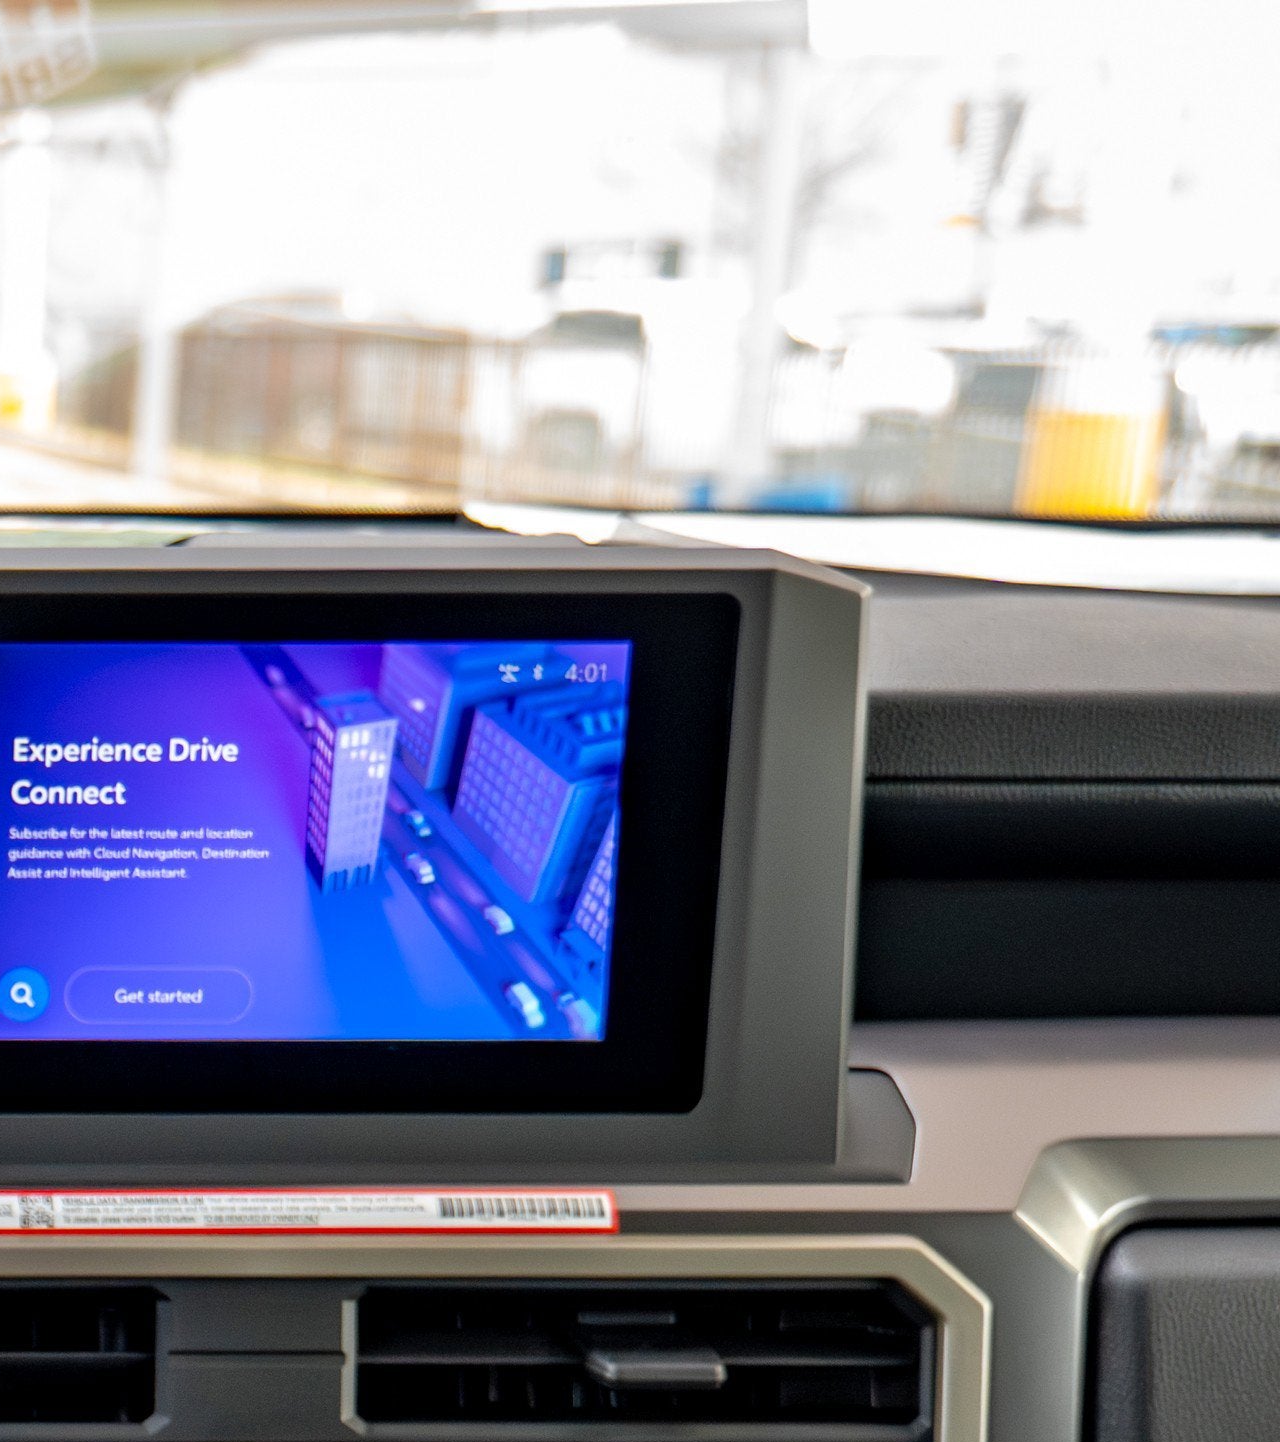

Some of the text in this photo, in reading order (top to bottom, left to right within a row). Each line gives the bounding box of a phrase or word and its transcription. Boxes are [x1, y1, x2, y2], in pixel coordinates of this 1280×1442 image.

[564, 662, 608, 683] 4:01
[12, 736, 239, 768] Experience Drive
[10, 779, 127, 806] Connect
[9, 827, 254, 840] Subscribe for the latest route and location
[7, 847, 269, 862] guidance with Cloud Navigation, Destination
[7, 867, 42, 879] Assist
[44, 867, 68, 879] and
[69, 867, 131, 881] Intelligent
[114, 988, 204, 1005] Get started
